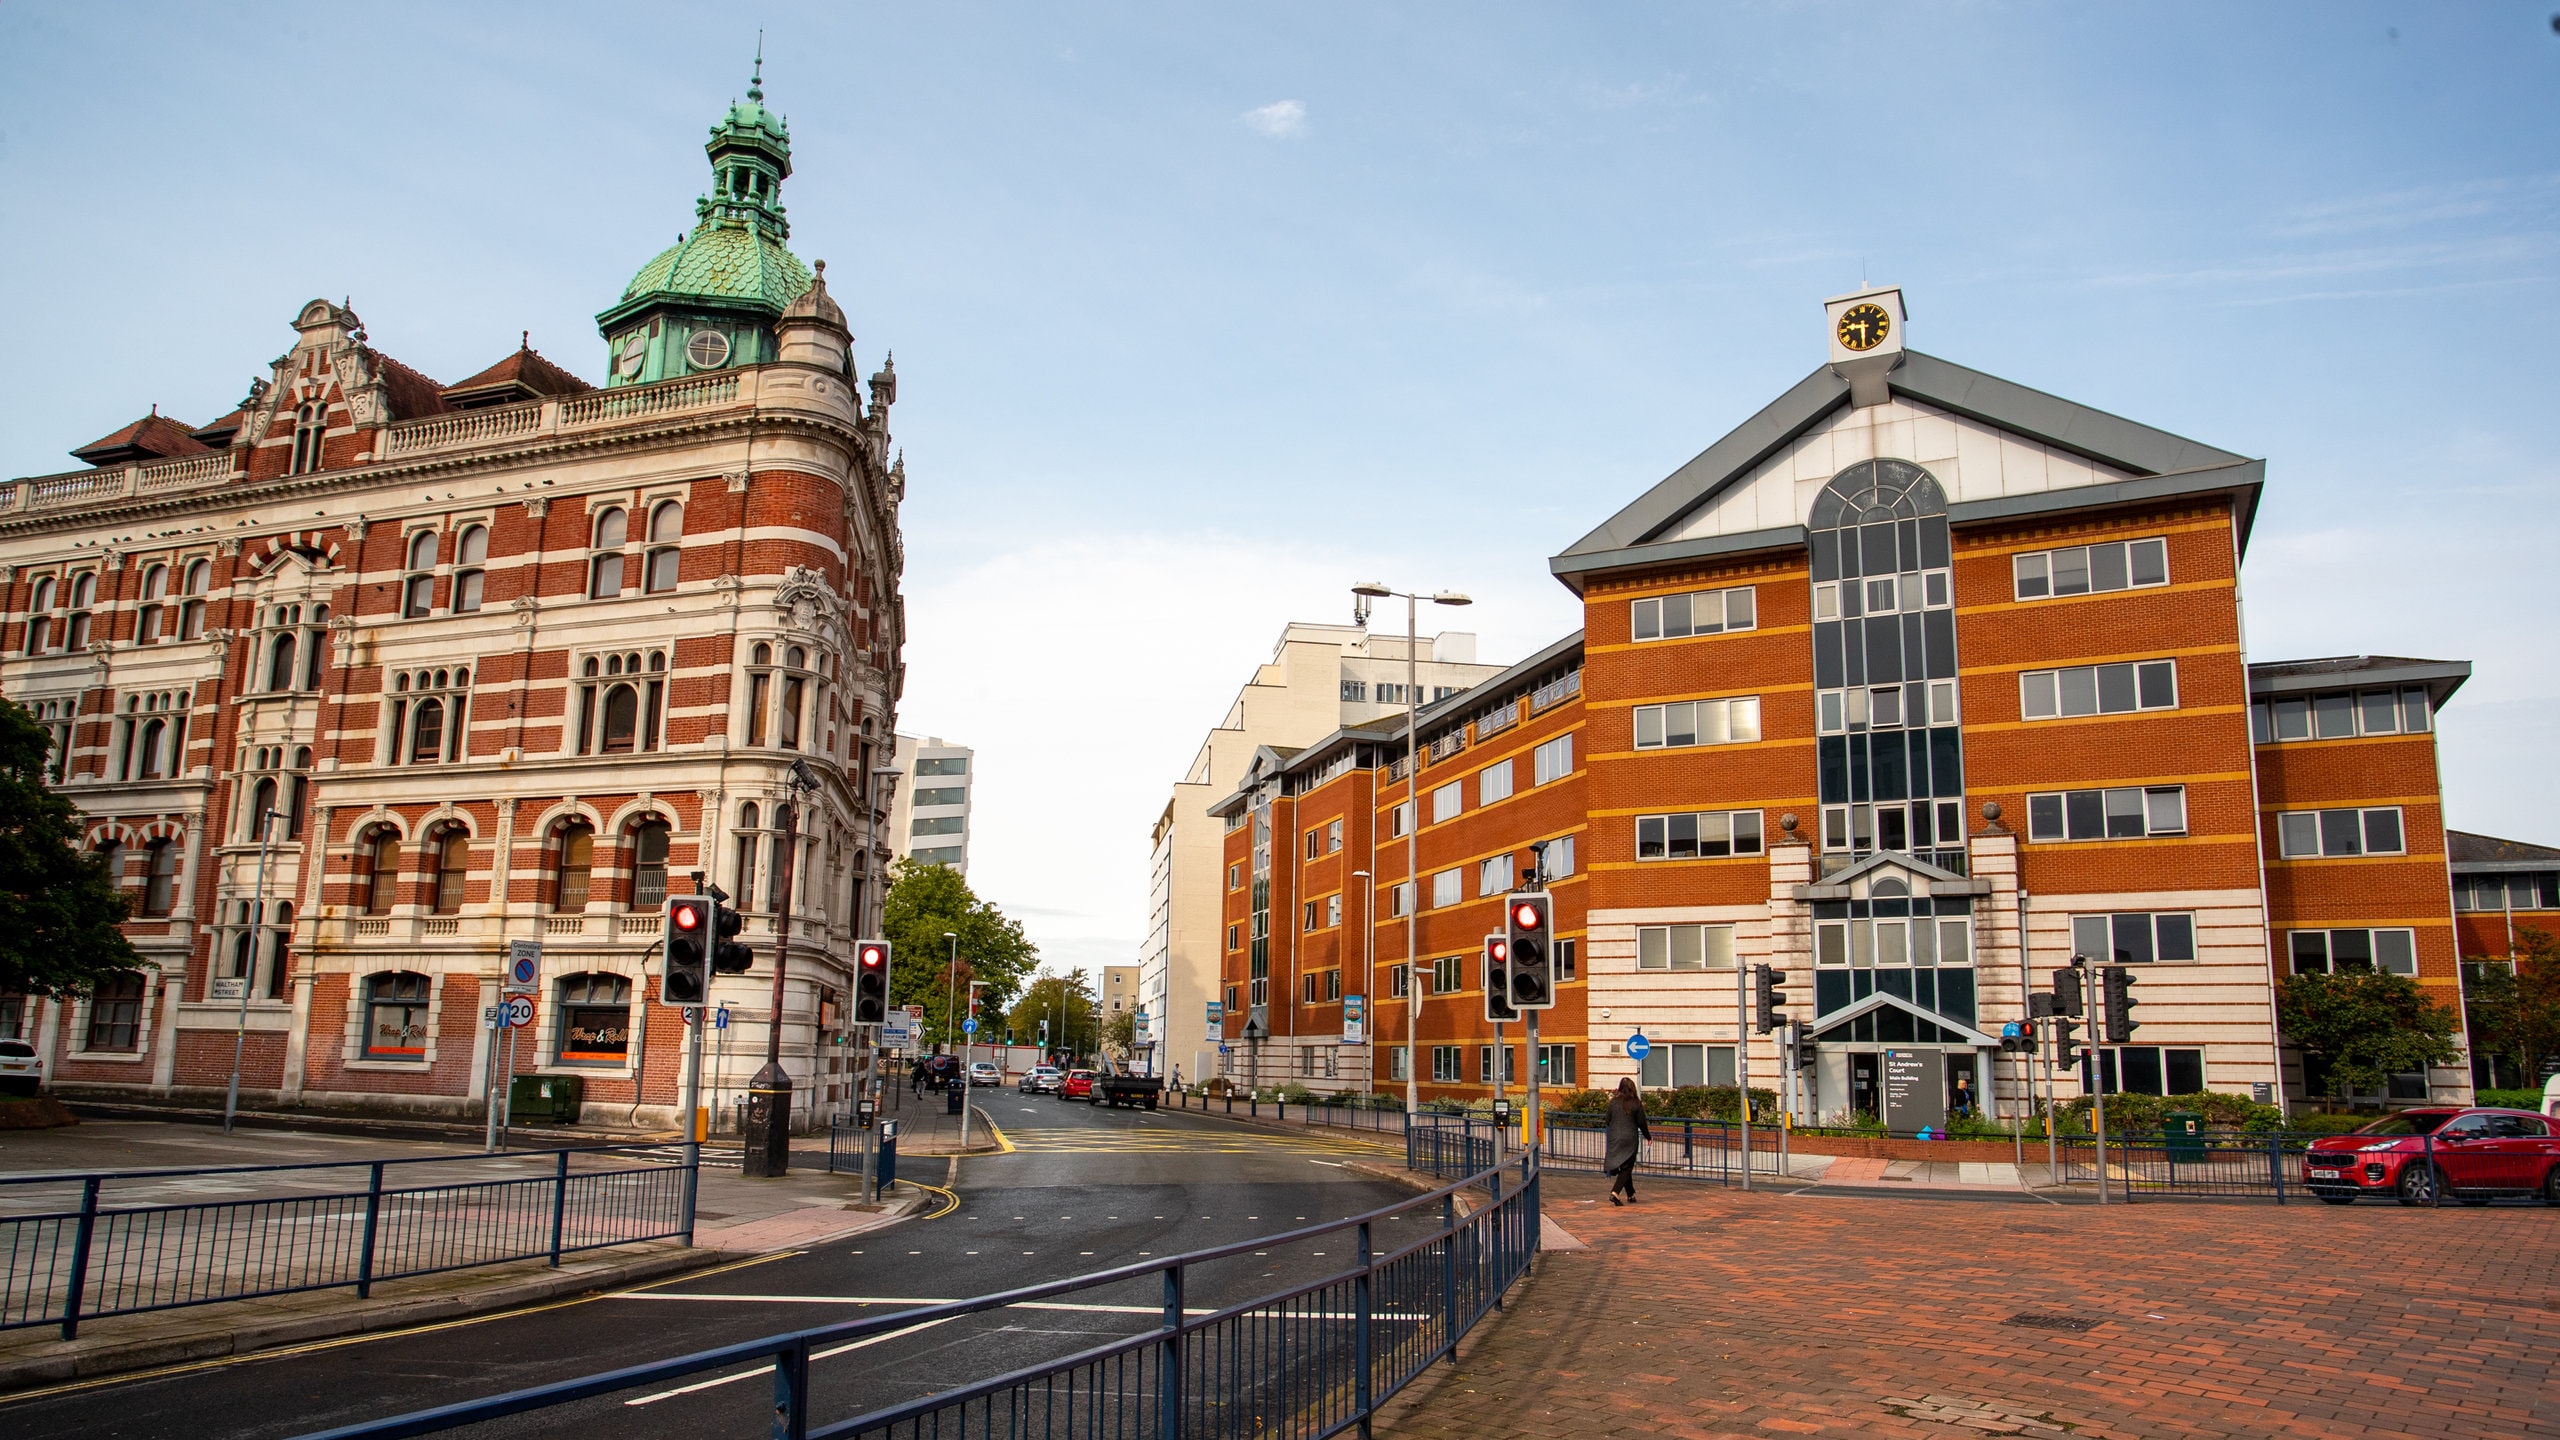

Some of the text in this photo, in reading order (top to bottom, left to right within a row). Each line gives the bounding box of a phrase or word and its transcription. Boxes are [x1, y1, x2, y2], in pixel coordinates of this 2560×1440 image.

[517, 949, 535, 958] ZONE
[511, 1005, 531, 1018] 20
[571, 1027, 629, 1045] Wrap & Roll
